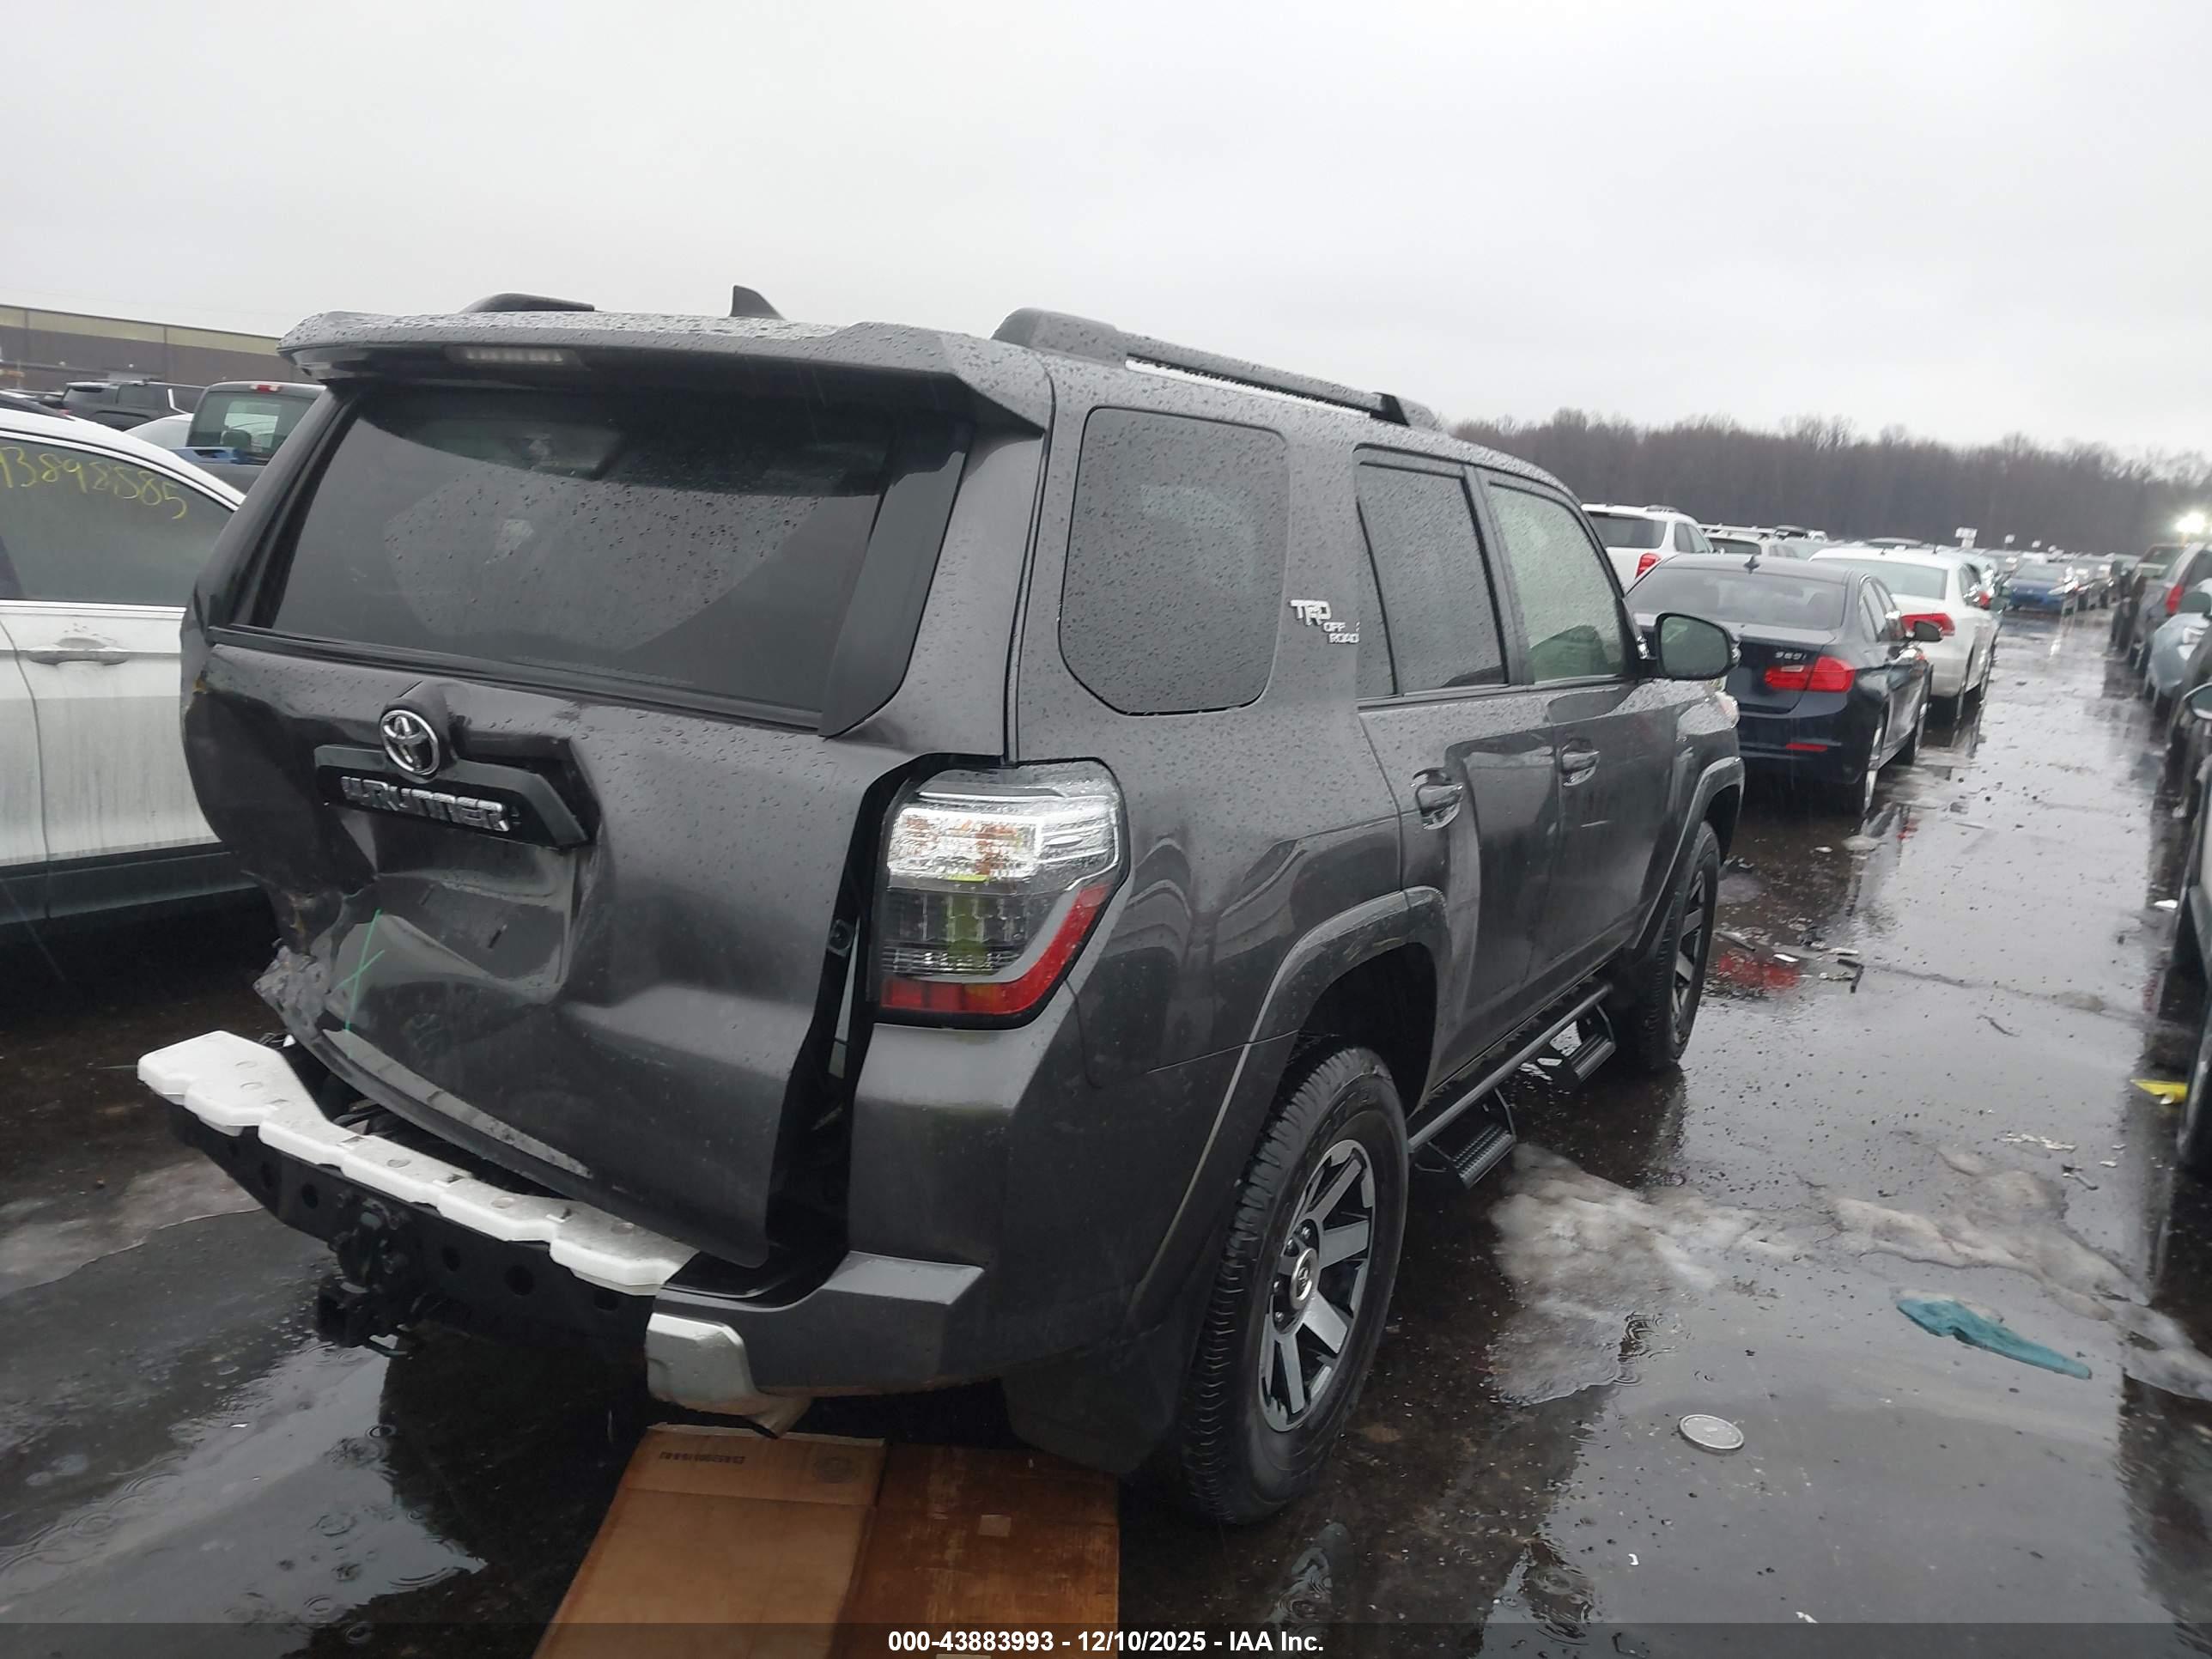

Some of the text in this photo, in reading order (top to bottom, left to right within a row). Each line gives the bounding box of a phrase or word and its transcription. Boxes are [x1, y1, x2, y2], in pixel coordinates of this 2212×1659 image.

[1291, 599, 1332, 626] TRD
[1323, 621, 1346, 632] OFF
[1328, 633, 1360, 644] ROAD
